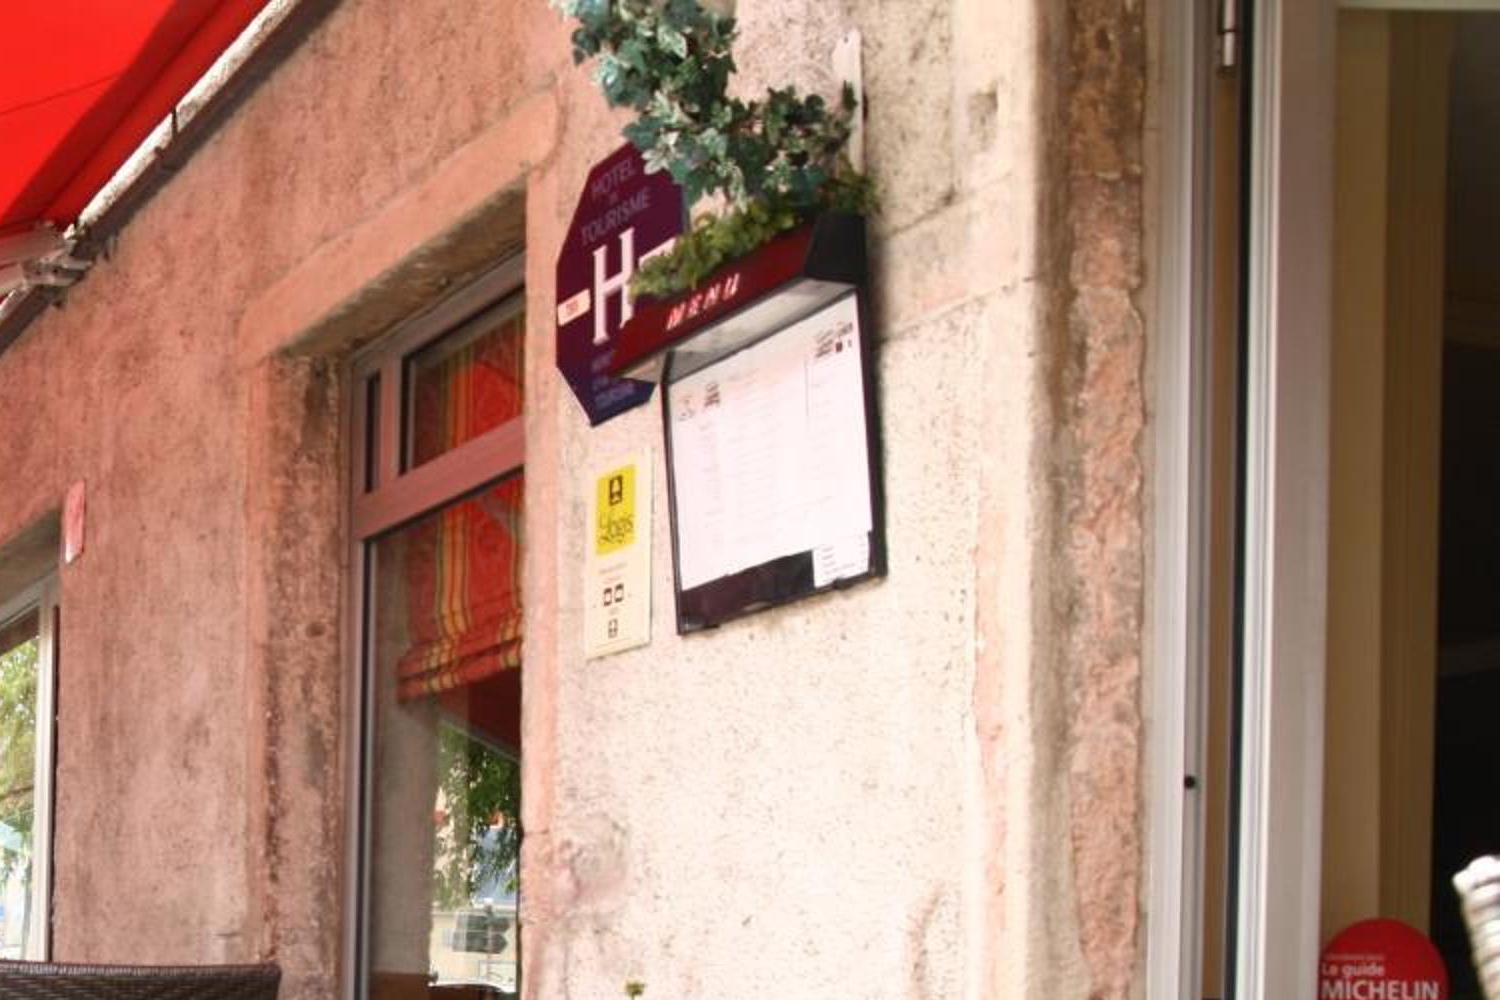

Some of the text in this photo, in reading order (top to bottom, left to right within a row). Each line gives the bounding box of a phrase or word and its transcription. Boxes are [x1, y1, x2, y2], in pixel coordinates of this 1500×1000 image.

[590, 159, 637, 198] HOTEL
[580, 187, 651, 247] TOURISME
[666, 272, 740, 331] MENU
[1341, 962, 1385, 978] guide
[1321, 980, 1440, 1000] MICHELIN
